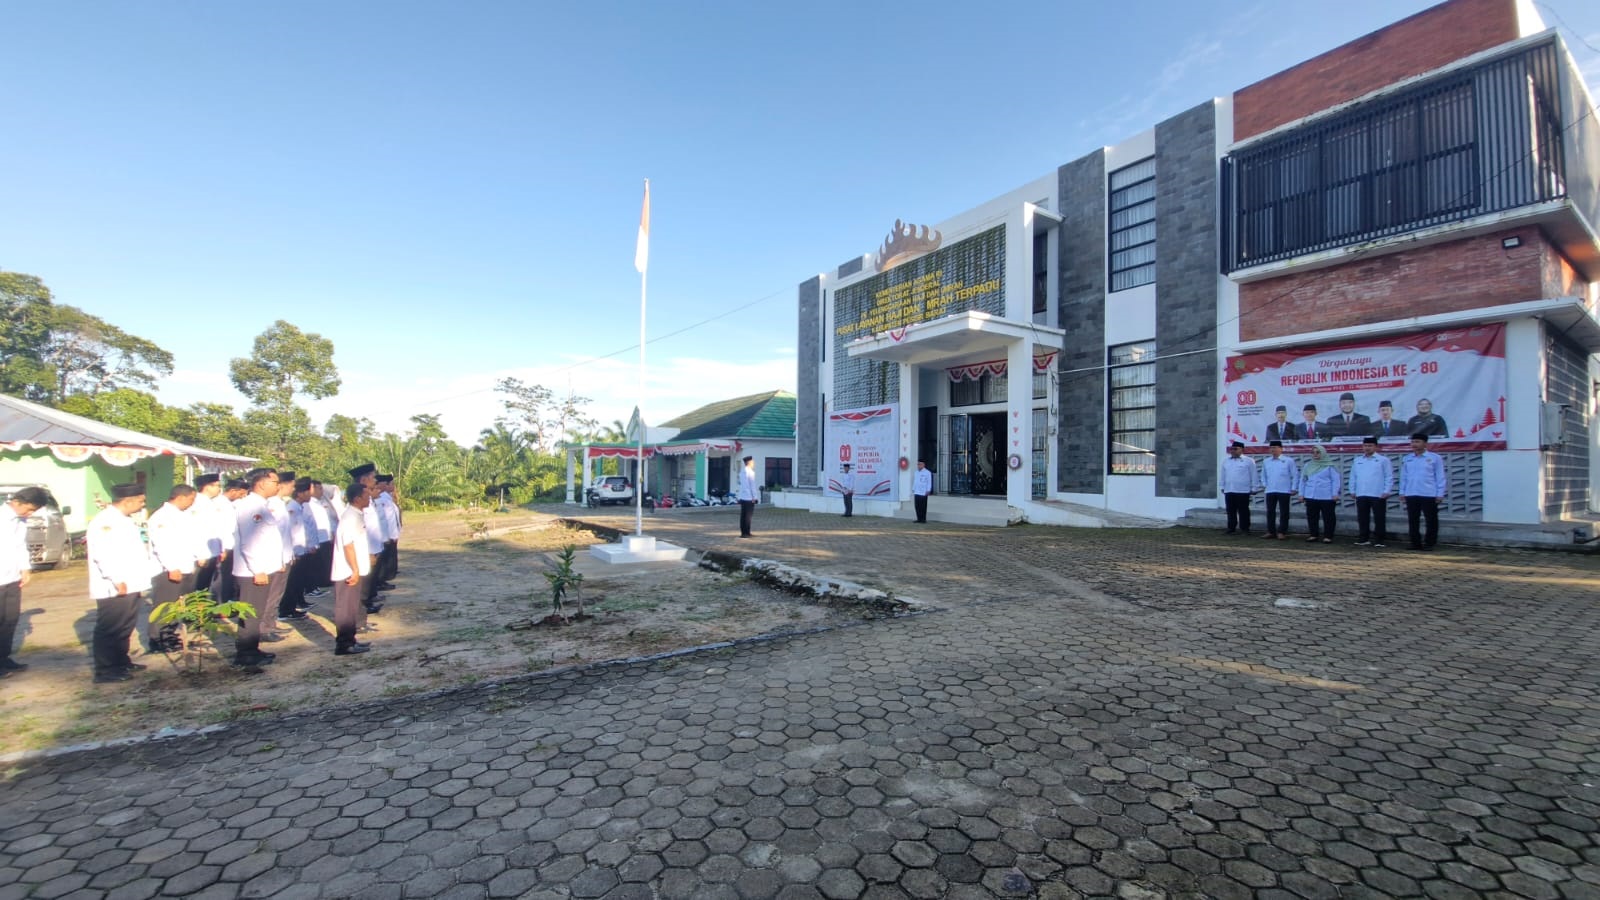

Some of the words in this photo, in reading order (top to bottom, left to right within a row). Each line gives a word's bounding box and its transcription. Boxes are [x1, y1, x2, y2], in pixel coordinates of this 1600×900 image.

[885, 309, 902, 320] HAJI
[904, 304, 920, 316] DAN
[955, 279, 1000, 300] TERPADU
[1281, 371, 1327, 387] REPUBLIK
[1331, 365, 1389, 382] INDONESIA
[1393, 363, 1408, 377] KE
[1420, 361, 1438, 375] 80
[1318, 356, 1372, 369] Dirgahayu
